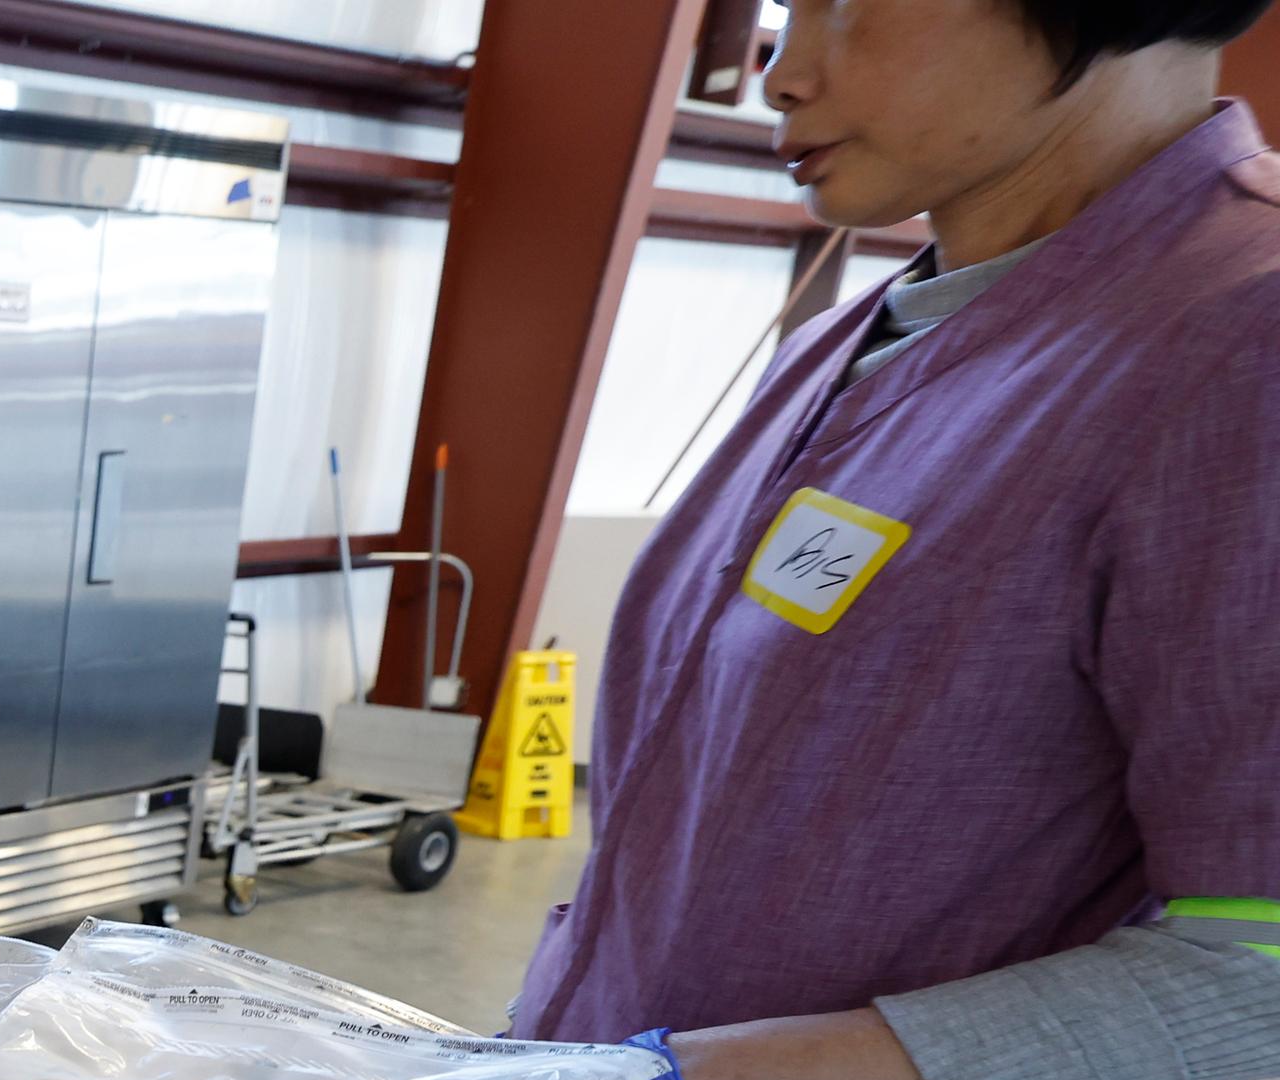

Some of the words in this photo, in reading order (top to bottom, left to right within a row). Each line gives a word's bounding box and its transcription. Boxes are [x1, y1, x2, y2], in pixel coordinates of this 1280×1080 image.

[169, 994, 187, 1004] PULL
[186, 994, 197, 1004] TO
[198, 994, 219, 1004] OPEN
[339, 1020, 362, 1034] PULL
[365, 1026, 380, 1038] TO
[380, 1030, 410, 1044] OPEN
